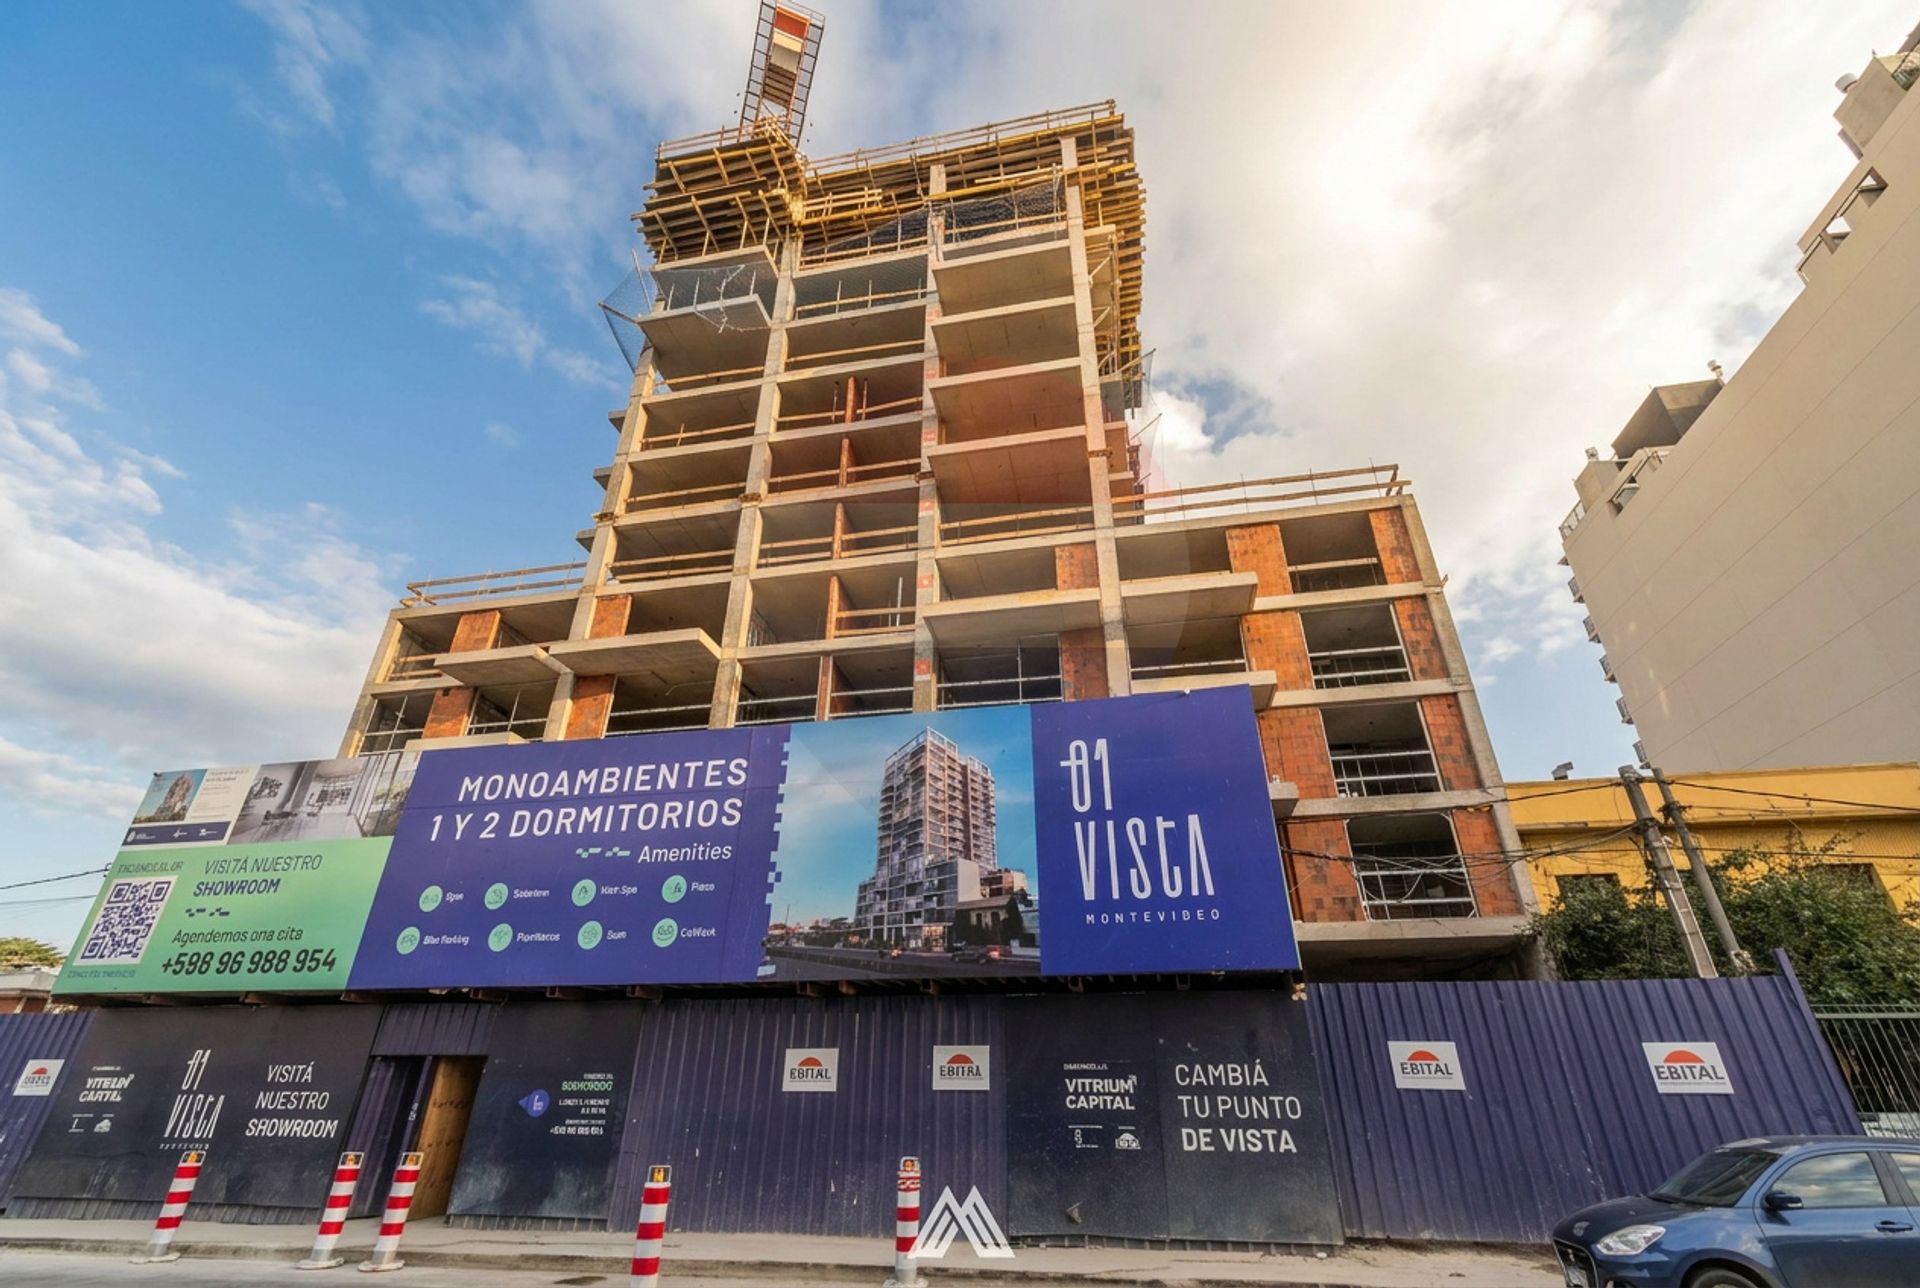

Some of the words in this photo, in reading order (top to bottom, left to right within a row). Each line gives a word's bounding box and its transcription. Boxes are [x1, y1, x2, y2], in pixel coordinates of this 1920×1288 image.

[458, 757, 748, 802] MONOAMBIENTES
[430, 814, 443, 842] 1
[453, 813, 475, 841] Y
[479, 811, 501, 839] 2
[509, 797, 743, 838] DORMITORIOS
[250, 854, 323, 873] NUESTRO
[637, 842, 733, 864] Amenities
[193, 878, 281, 897] SHOWROOM
[172, 929, 249, 948] Agendemos
[276, 926, 304, 942] cita
[161, 951, 215, 976] +598
[215, 950, 246, 975] 96
[246, 949, 291, 974] 988
[292, 948, 337, 973] 954
[267, 1061, 315, 1083] VISITÁ
[1175, 1058, 1269, 1087] CAMBIÁ
[1400, 1061, 1454, 1077] EBITAL
[1653, 1064, 1725, 1081] EBITAL
[1064, 1078, 1135, 1094] VITRIUM
[255, 1091, 330, 1110] NUESTRO
[1065, 1095, 1136, 1111] CAPITAL
[1177, 1095, 1210, 1119] TU
[1218, 1096, 1302, 1121] PUNTO
[245, 1118, 339, 1139] SHOWROOM
[1181, 1128, 1215, 1152] DE
[1219, 1128, 1298, 1154] VISTA
